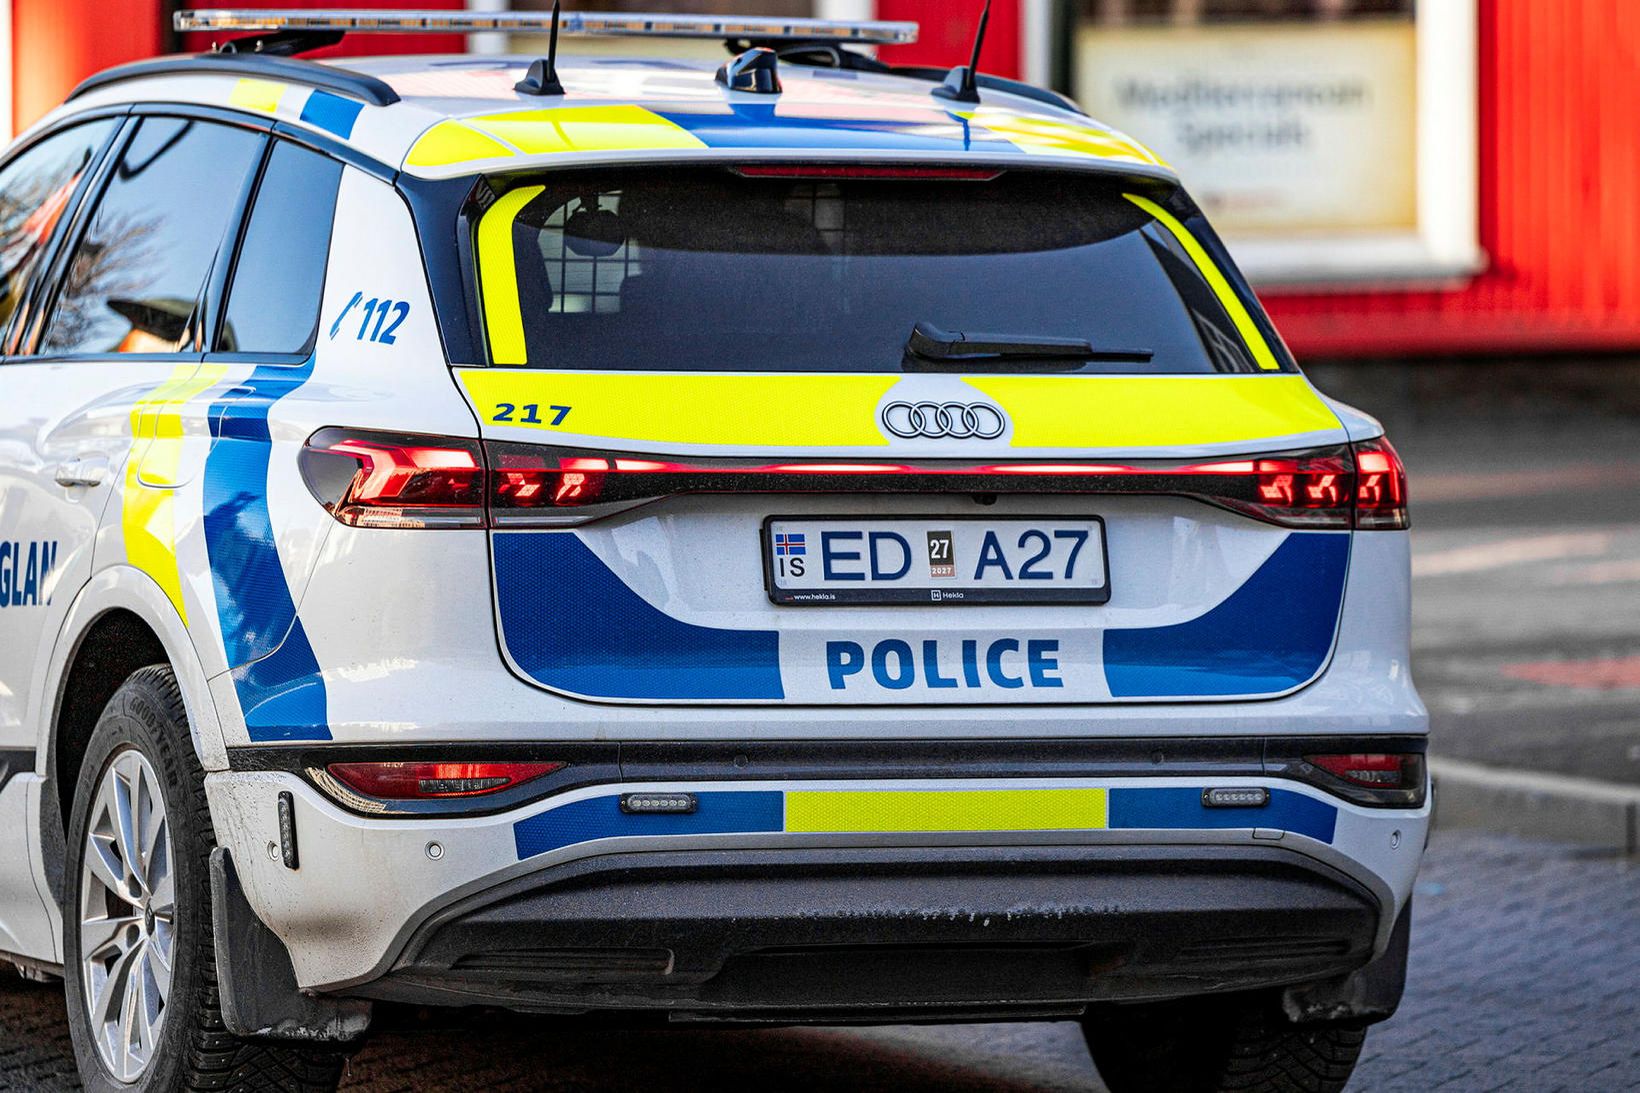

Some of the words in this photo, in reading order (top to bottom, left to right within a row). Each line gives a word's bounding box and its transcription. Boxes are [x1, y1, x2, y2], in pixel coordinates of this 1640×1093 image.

[356, 297, 411, 346] 112
[492, 402, 573, 426] 217
[820, 531, 912, 581] ED
[973, 529, 1089, 580] A27
[929, 539, 950, 559] 27
[779, 557, 806, 577] IS
[931, 567, 952, 575] 2027
[825, 637, 1065, 690] POLICE
